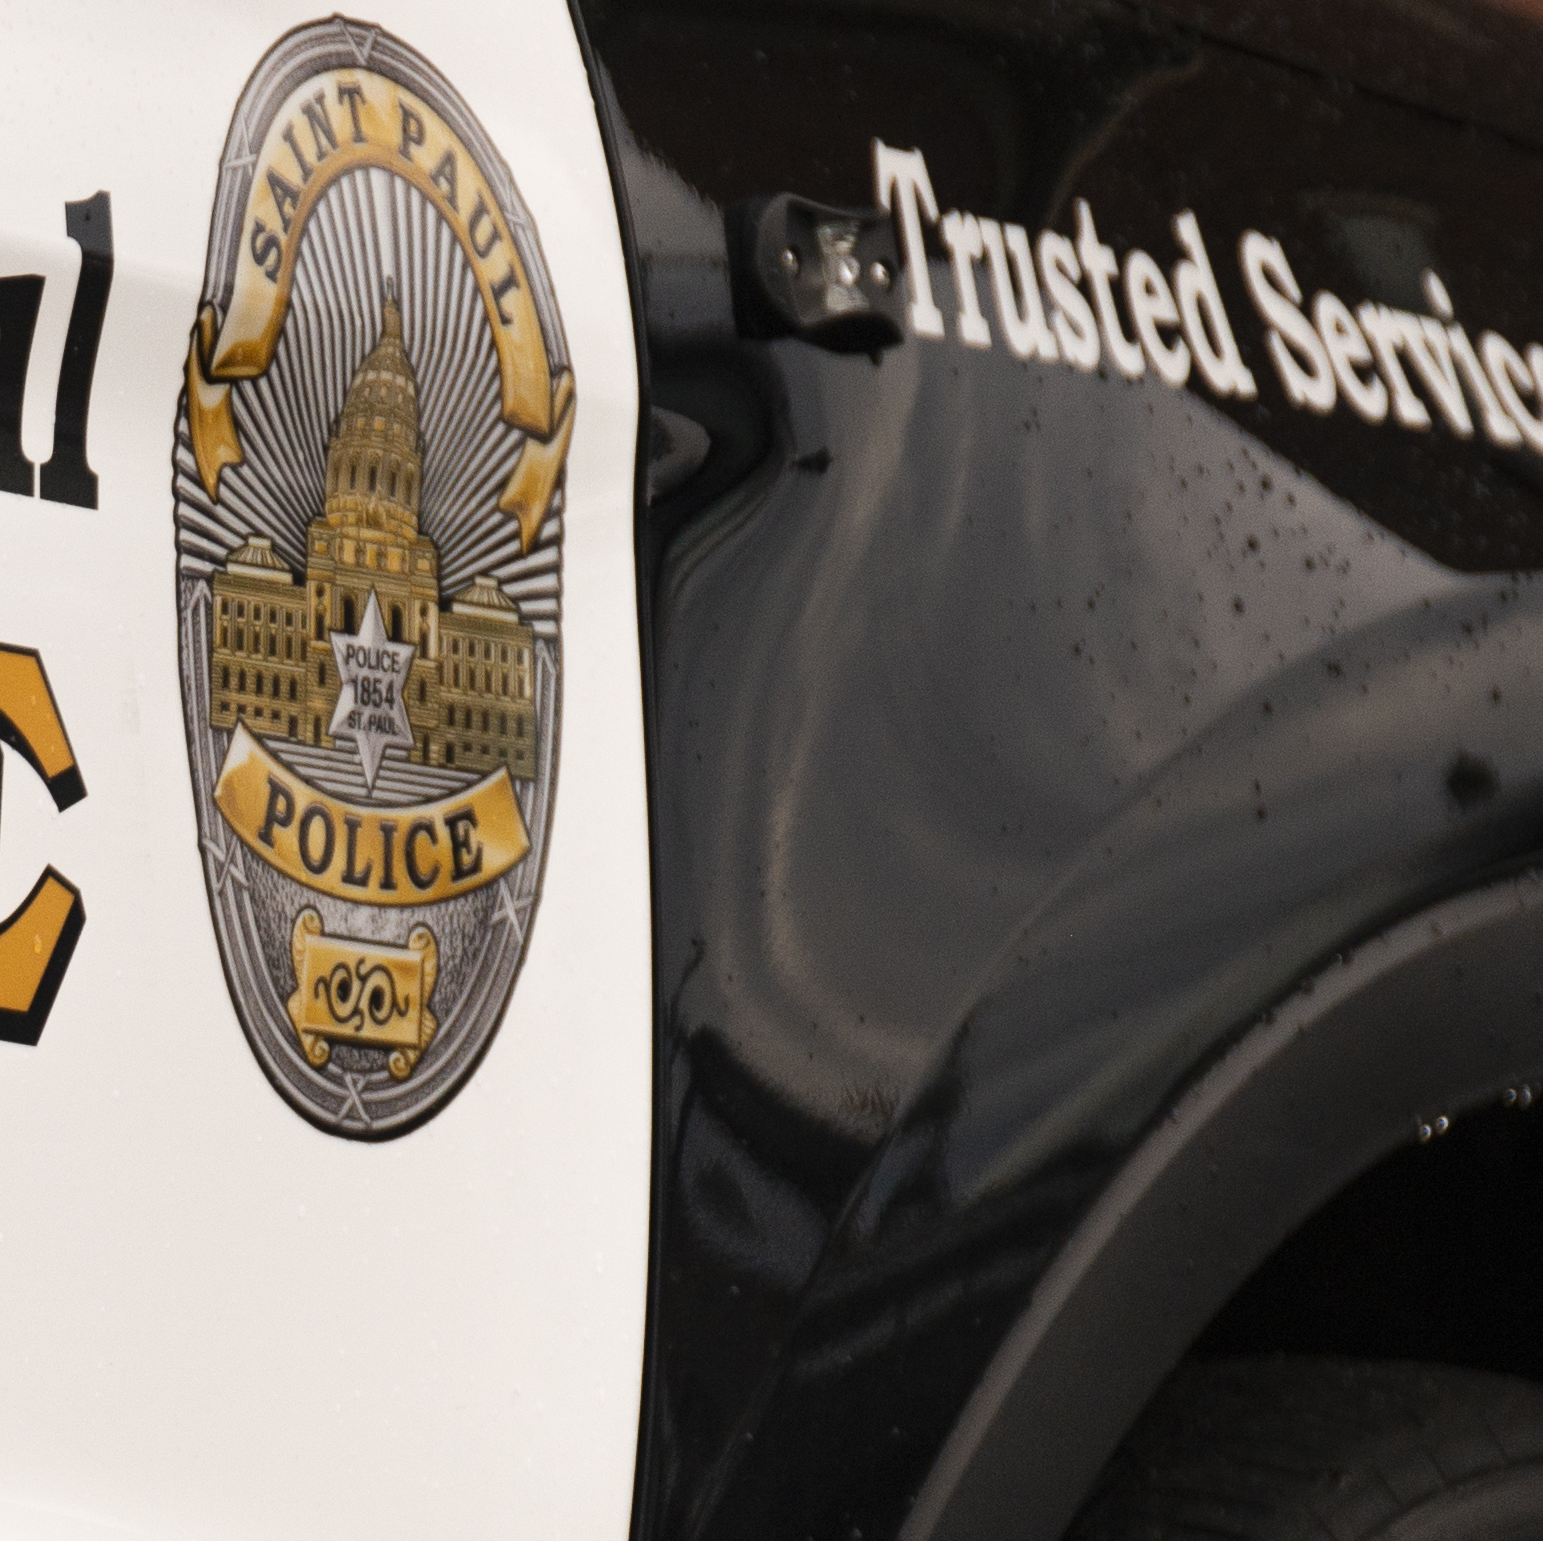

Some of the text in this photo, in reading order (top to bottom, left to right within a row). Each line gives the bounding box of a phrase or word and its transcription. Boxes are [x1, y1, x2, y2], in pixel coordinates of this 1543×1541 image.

[250, 80, 520, 327] SAINT PAUL
[872, 137, 1256, 400] Trusted
[345, 643, 401, 674] POLICE
[350, 675, 396, 710] 1854
[367, 712, 399, 736] PAUL
[257, 772, 484, 892] POLICE
